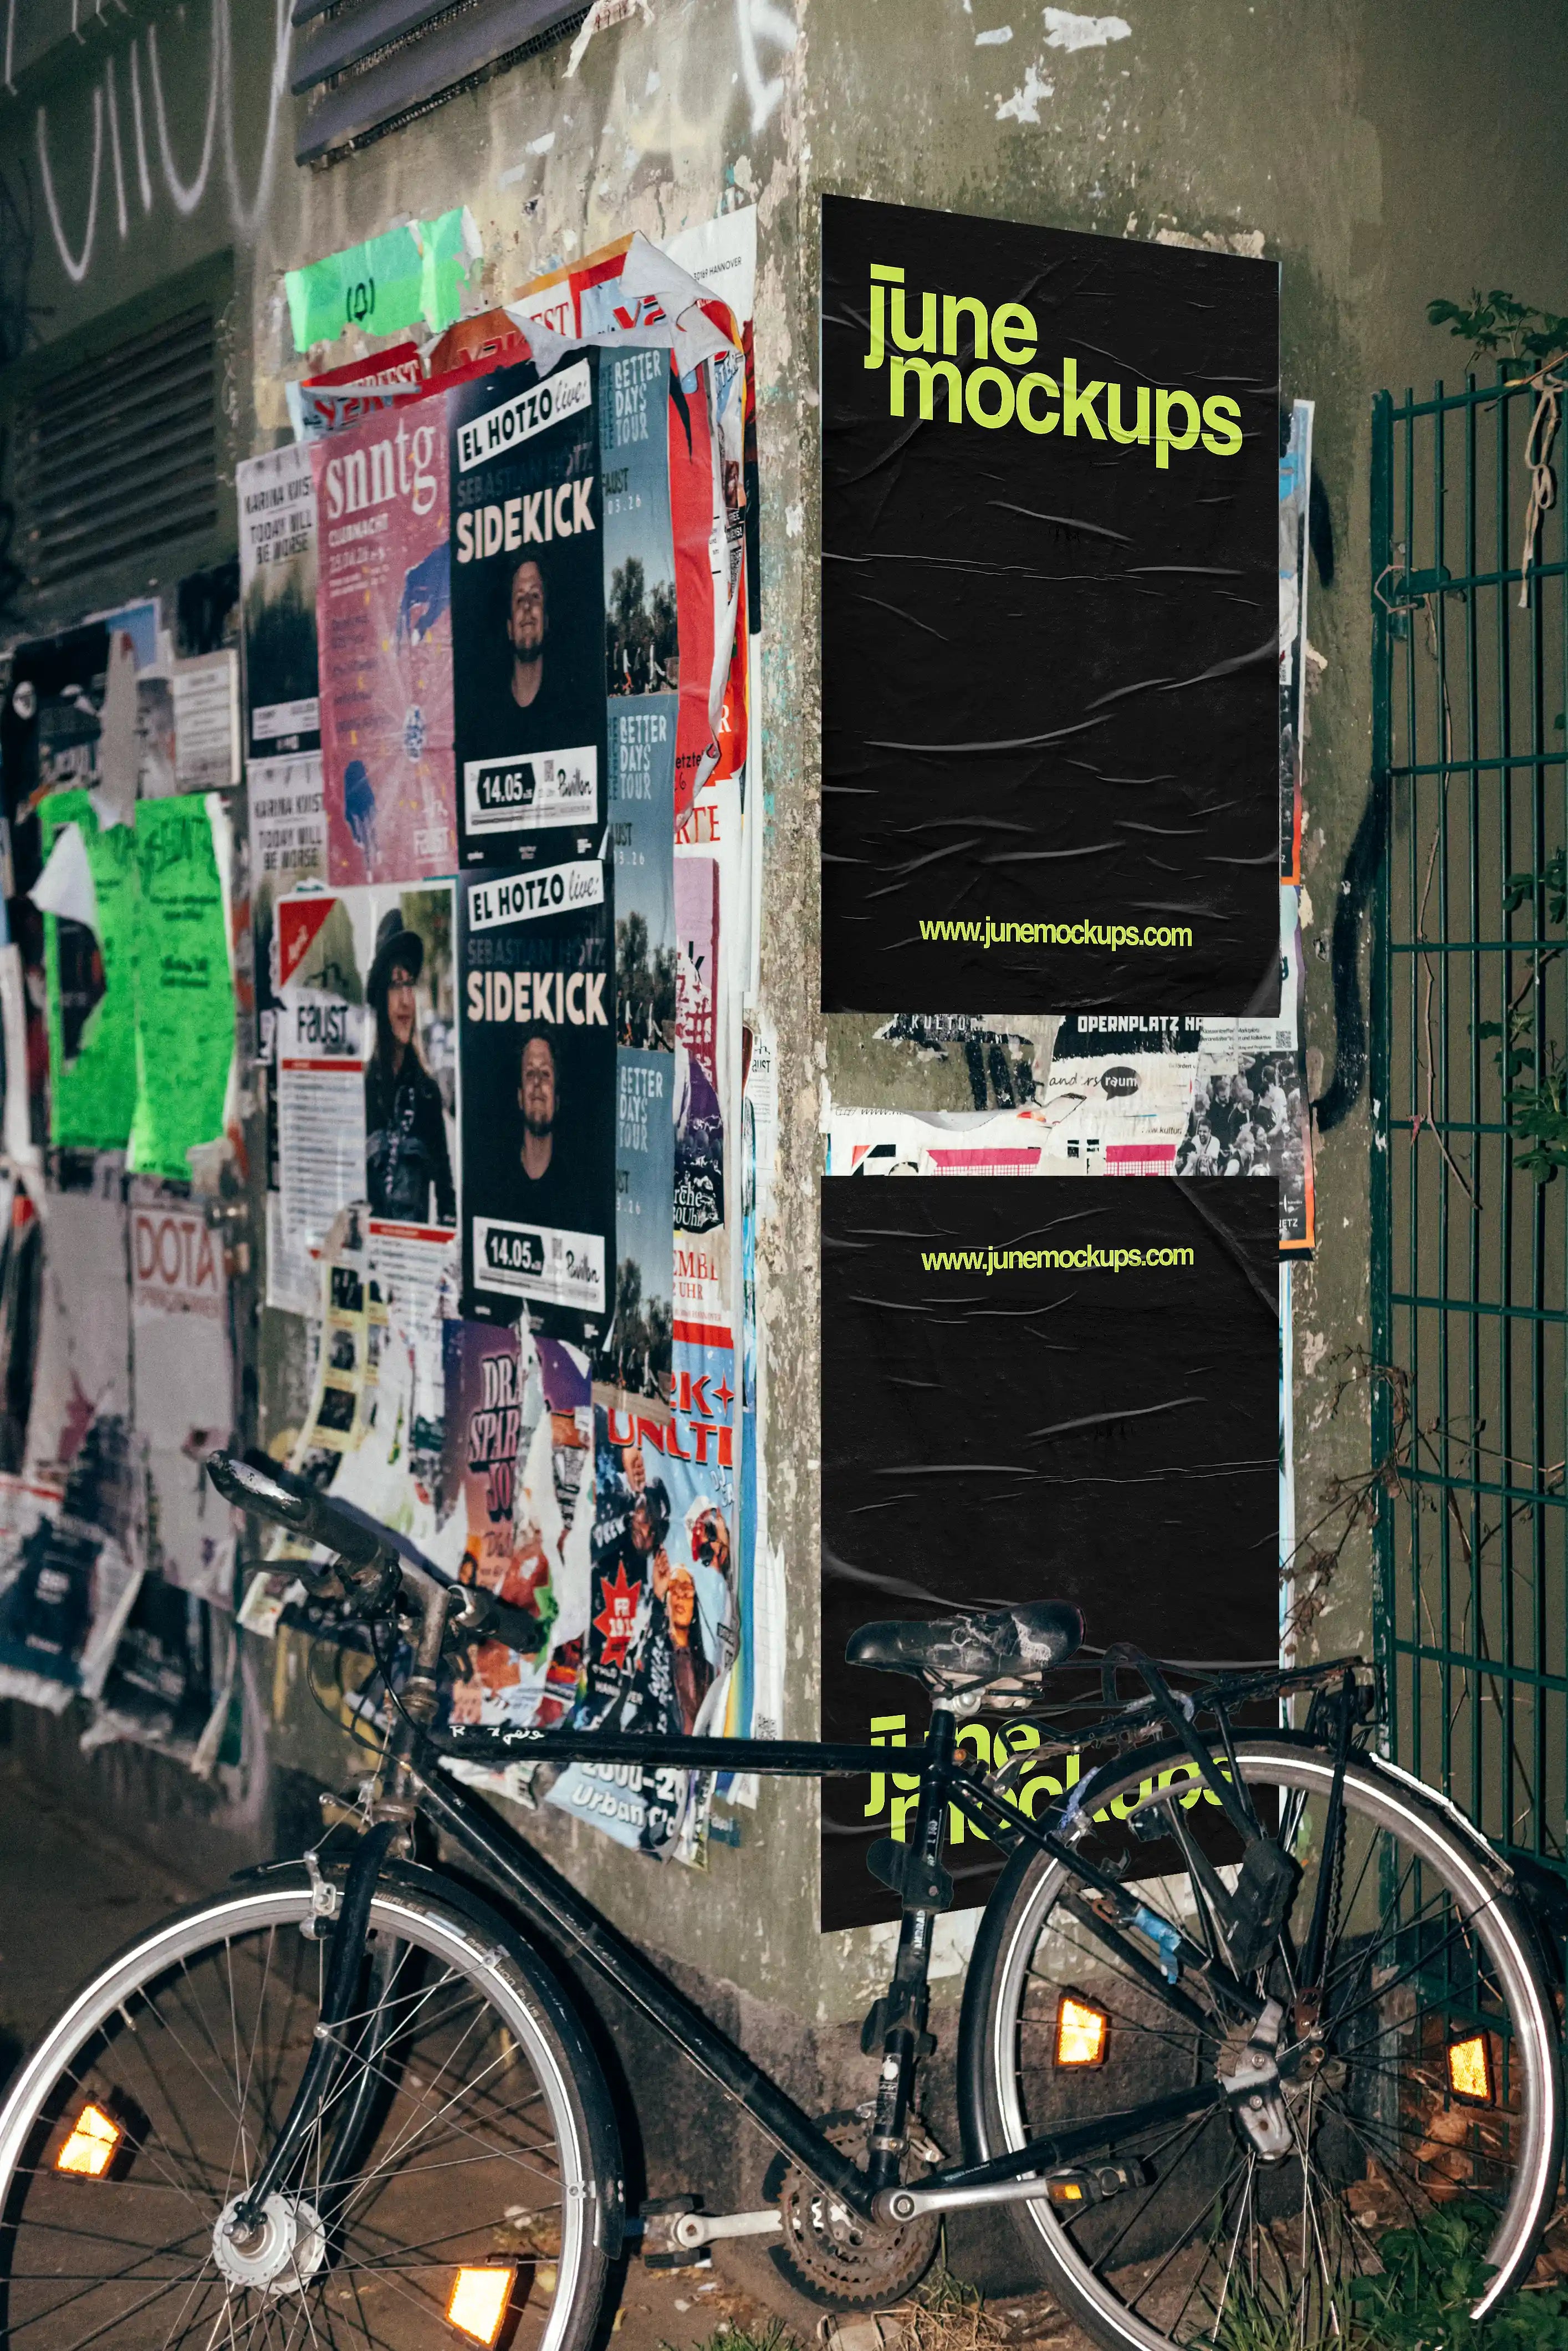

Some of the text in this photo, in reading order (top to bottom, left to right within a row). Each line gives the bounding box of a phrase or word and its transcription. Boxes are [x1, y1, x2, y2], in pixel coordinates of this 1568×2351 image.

[709, 256, 742, 276] HANNOVER
[864, 263, 1038, 369] june
[614, 350, 662, 389] BETTER
[615, 383, 647, 418] DAYS
[890, 356, 1243, 470] mockups
[462, 427, 483, 462] EL
[488, 388, 553, 450] HOTZO
[616, 412, 648, 447] TOUR
[326, 417, 438, 520] snntg
[456, 477, 595, 563] SIDEKICK
[620, 715, 667, 744] BETTER
[620, 744, 651, 772] DAYS
[620, 772, 652, 800] TOUR
[473, 891, 492, 922] EL
[498, 874, 564, 916] HOTZO
[919, 916, 1192, 951] www.junemockups.com
[467, 971, 609, 1026] SIDEKICK
[1077, 1016, 1179, 1032] OPERNPLATZ
[621, 1066, 663, 1098] BETTER
[1105, 1077, 1138, 1088] raum
[620, 1093, 648, 1124] DAYS
[619, 1120, 648, 1153] TOUR
[138, 1216, 217, 1292] DOTA
[921, 1244, 1194, 1276] www.junemockups.com
[679, 1283, 703, 1301] UHR
[571, 1783, 646, 1828] Urban
